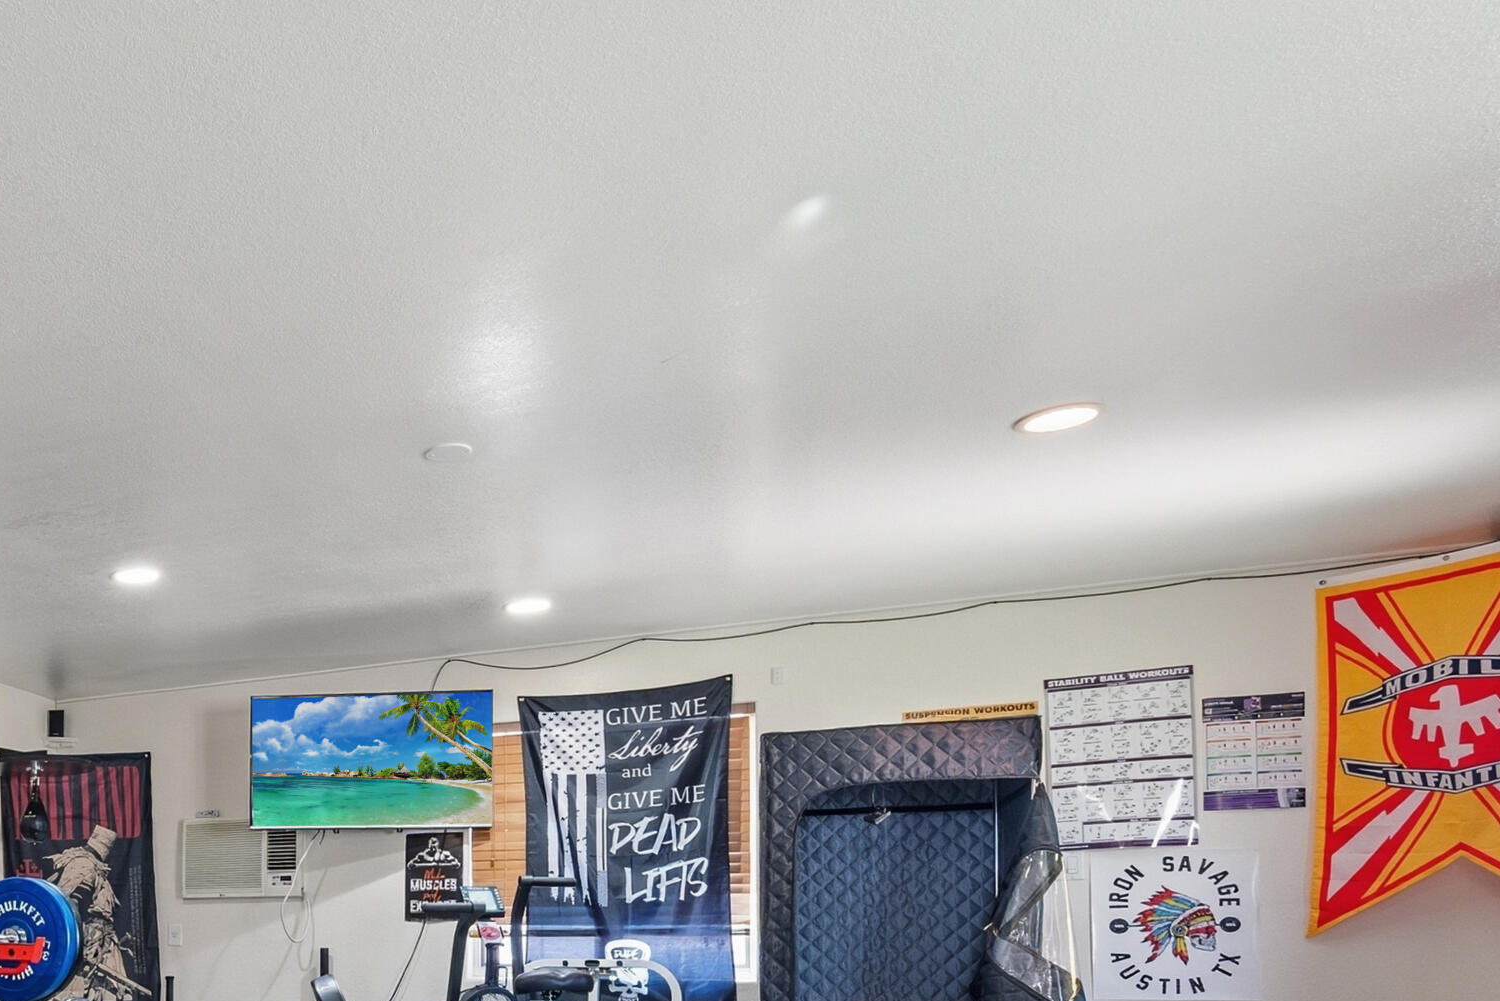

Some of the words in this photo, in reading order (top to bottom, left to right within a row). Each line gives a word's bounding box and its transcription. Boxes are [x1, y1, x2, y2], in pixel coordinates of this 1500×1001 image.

[1048, 676, 1097, 689] STABILITY
[1100, 673, 1126, 684] BALL
[1129, 667, 1190, 680] WORKOUTS
[605, 704, 662, 726] GIVE
[670, 696, 708, 719] ME
[973, 702, 1036, 714] WORKOUTS
[607, 724, 704, 773] Liberty
[621, 764, 652, 779] and
[1388, 764, 1500, 790] INFANT
[607, 789, 663, 810] GIVE
[671, 784, 706, 805] ME
[608, 813, 701, 855] DEAD
[410, 878, 457, 892] MUSCLES
[625, 857, 708, 904] LIFTS
[1109, 865, 1145, 909] IRON
[1162, 856, 1241, 907] SAVAGE
[1110, 953, 1206, 995] AUSTIN
[1212, 953, 1242, 977] TX
